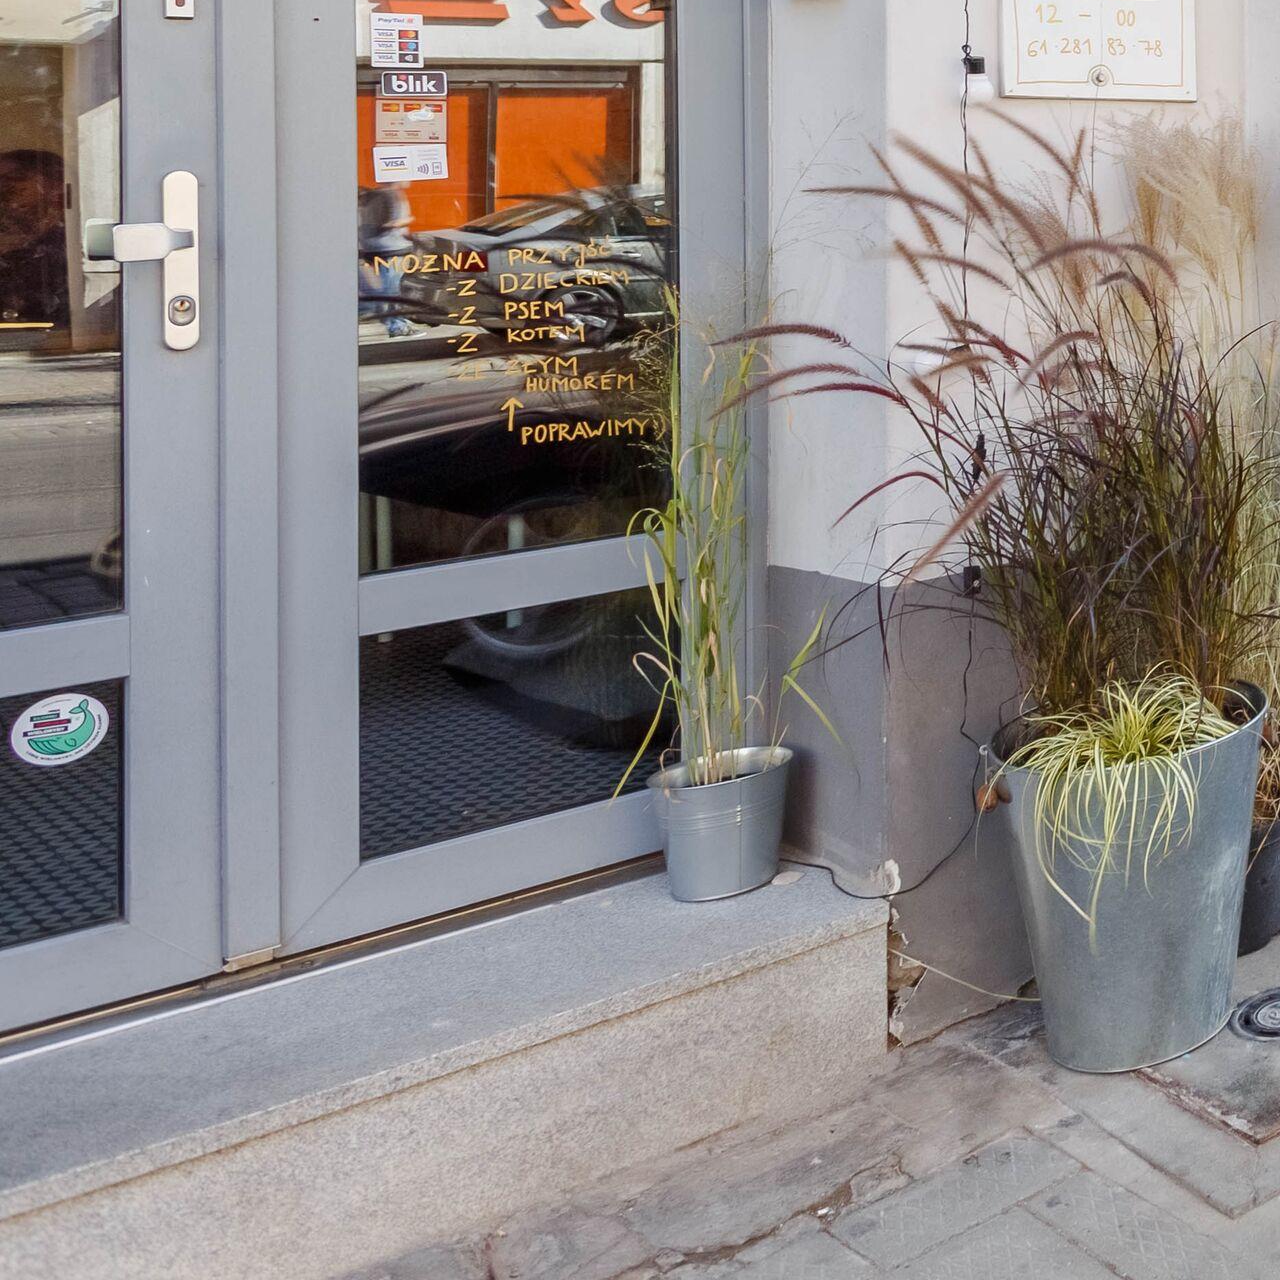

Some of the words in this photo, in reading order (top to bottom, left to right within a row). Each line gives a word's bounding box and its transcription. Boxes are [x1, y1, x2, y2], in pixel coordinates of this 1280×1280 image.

[1034, 4, 1063, 24] 12
[1116, 8, 1137, 27] 00
[1026, 38, 1048, 58] 61
[1107, 37, 1127, 57] 83
[1139, 38, 1164, 58] 78
[391, 74, 438, 93] blik
[499, 268, 630, 295] DZIECKIEM
[504, 300, 565, 321] PSEM
[507, 324, 586, 343] KOTEM
[525, 371, 636, 394] HUMOREM
[520, 417, 650, 446] POPRAWIMY
